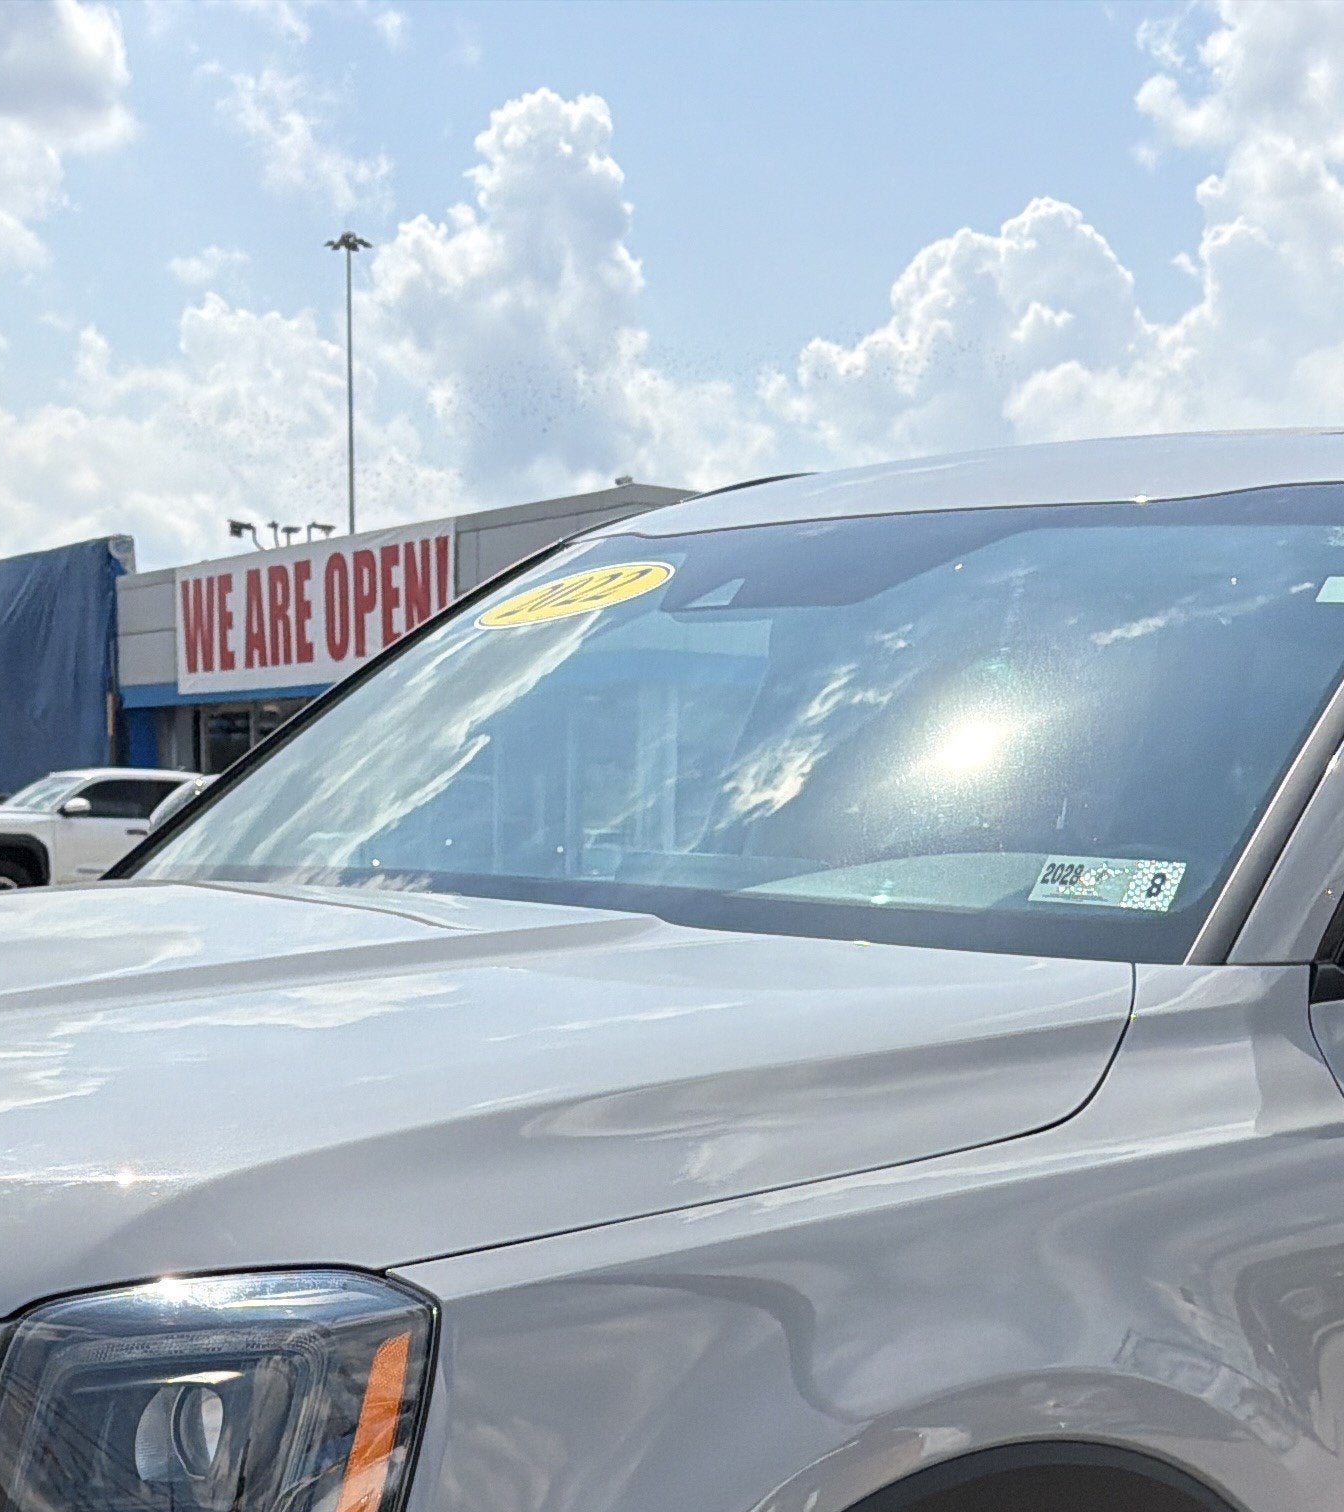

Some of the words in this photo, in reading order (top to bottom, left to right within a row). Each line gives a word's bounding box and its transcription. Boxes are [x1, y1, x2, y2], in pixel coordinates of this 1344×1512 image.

[181, 573, 236, 673] WE
[245, 559, 314, 669] ARE
[324, 535, 449, 662] OPEN!
[495, 567, 653, 620] 2022
[1040, 862, 1085, 886] 2028
[1146, 872, 1167, 898] 8
